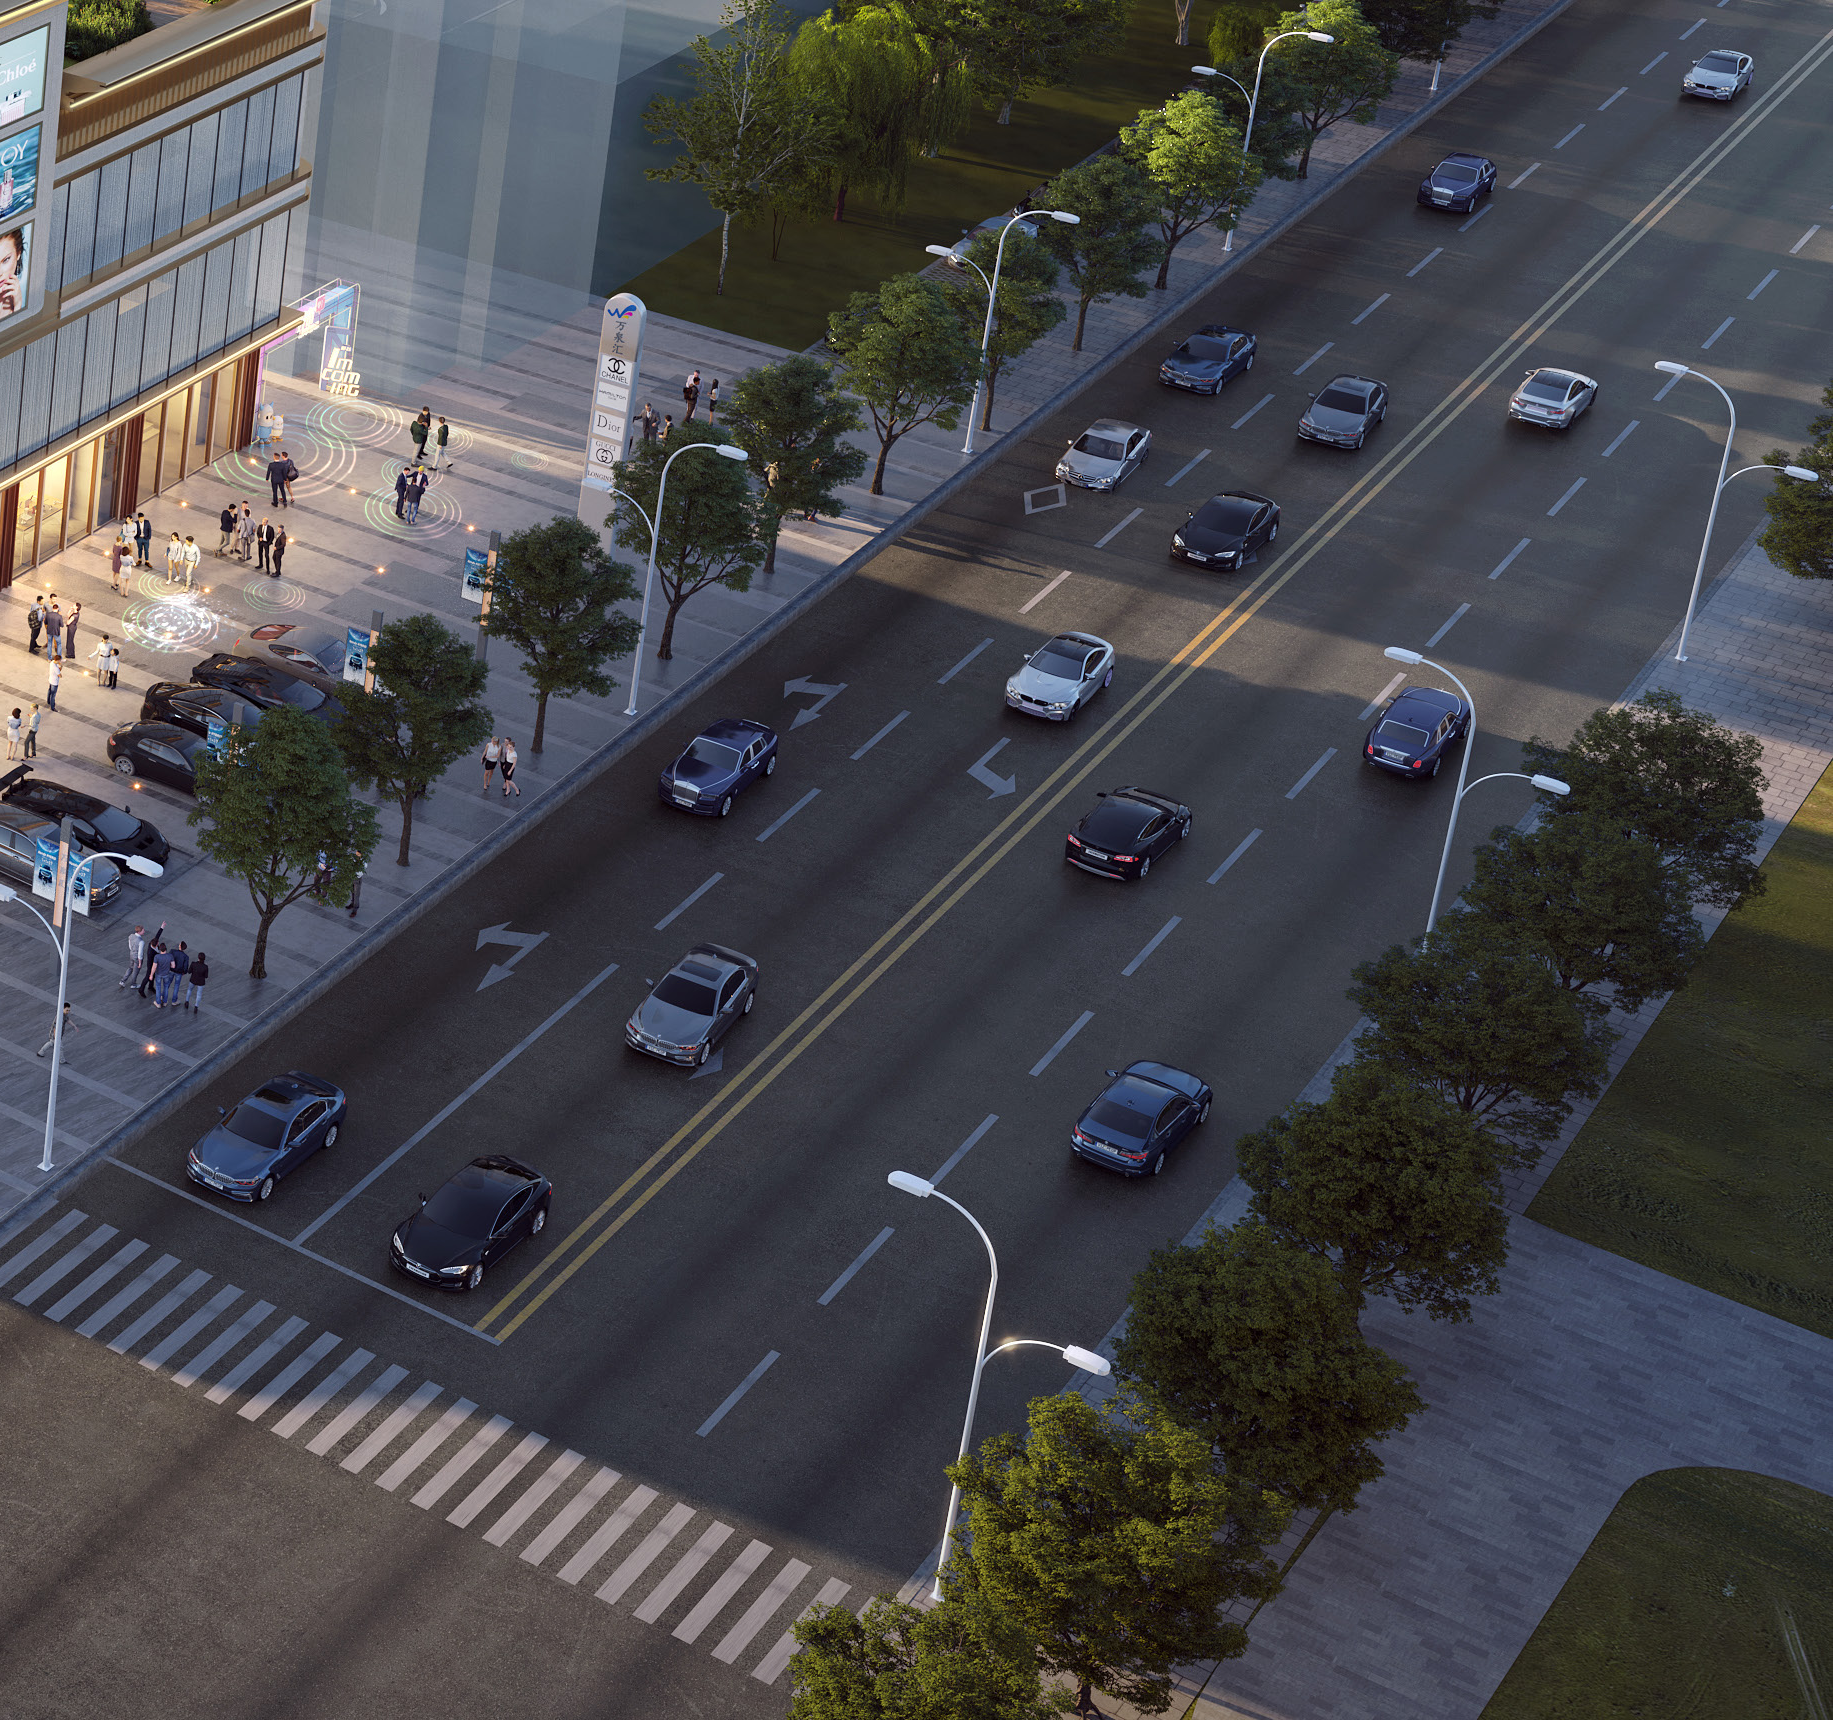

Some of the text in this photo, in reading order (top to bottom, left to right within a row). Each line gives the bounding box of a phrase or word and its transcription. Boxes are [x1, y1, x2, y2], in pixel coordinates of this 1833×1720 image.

[612, 320, 626, 355] 万泉汇
[601, 370, 628, 385] CHANEL
[596, 414, 621, 434] Dior
[595, 440, 616, 452] GUCCI
